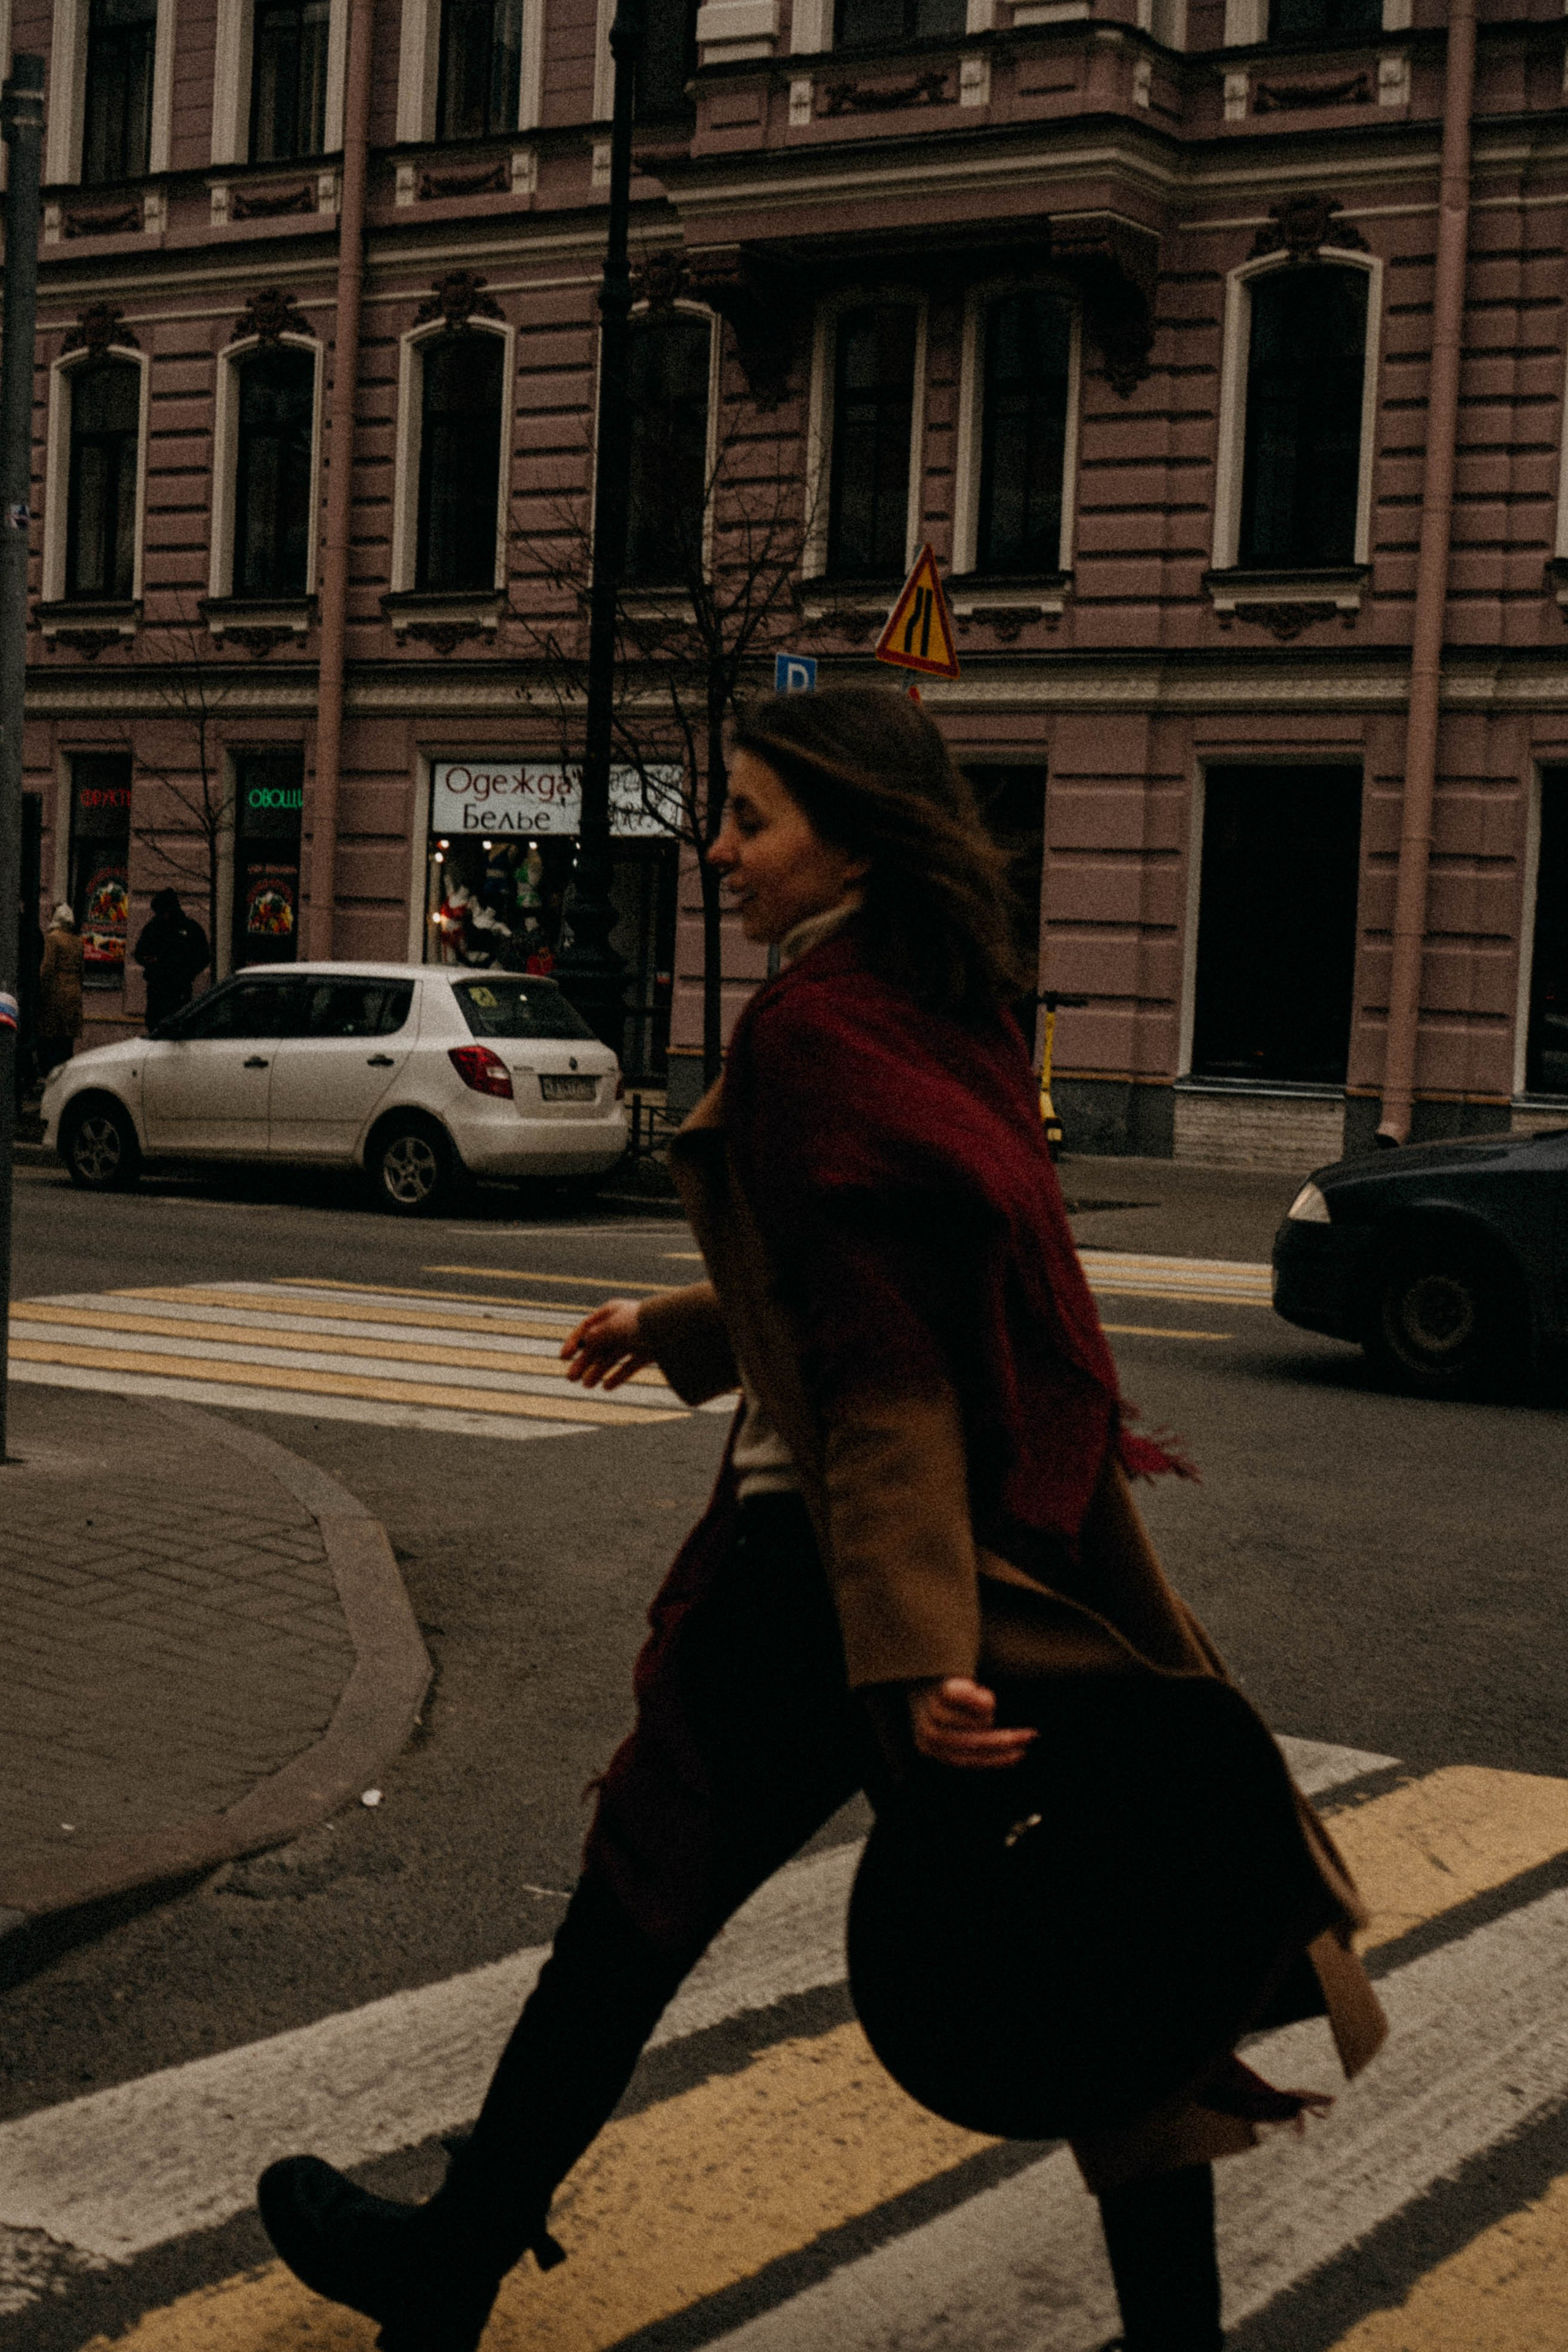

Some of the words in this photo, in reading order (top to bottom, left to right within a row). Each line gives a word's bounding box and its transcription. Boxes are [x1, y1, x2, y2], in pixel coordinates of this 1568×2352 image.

[80, 788, 132, 807] ФРУКТ
[446, 766, 571, 802] Одежда
[462, 803, 551, 831] Белье
